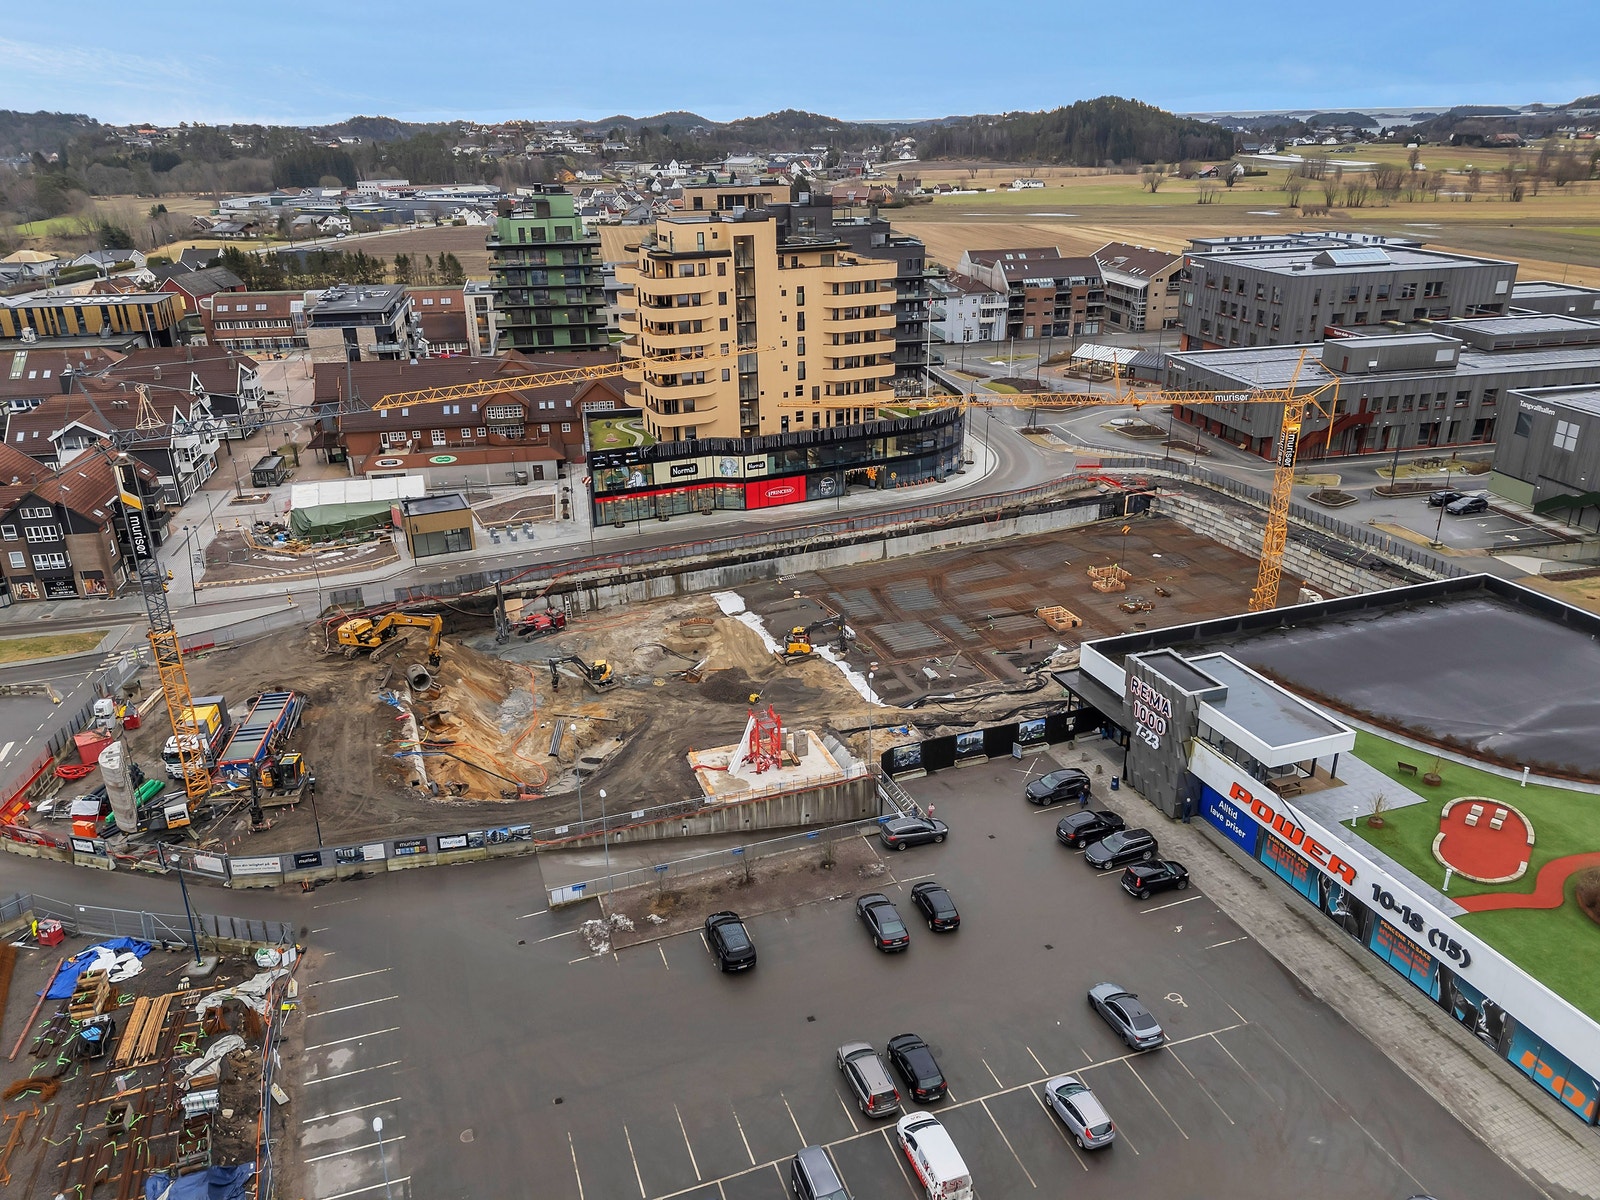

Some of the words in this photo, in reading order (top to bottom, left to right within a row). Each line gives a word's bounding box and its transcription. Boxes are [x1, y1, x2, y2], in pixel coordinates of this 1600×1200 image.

[1215, 393, 1249, 403] murisør
[748, 462, 764, 470] Normal
[1284, 434, 1295, 467] murisør
[672, 465, 696, 476] Normal
[129, 516, 147, 555] murisør
[1130, 675, 1173, 719] REMA
[1133, 700, 1167, 736] 1000
[1209, 805, 1225, 822] lave
[1225, 818, 1247, 839] priser
[1218, 801, 1238, 820] Alltid
[1229, 782, 1357, 886] POWER
[1372, 883, 1425, 933] 10-18
[1428, 928, 1471, 969] (15)
[1397, 942, 1410, 954] DU
